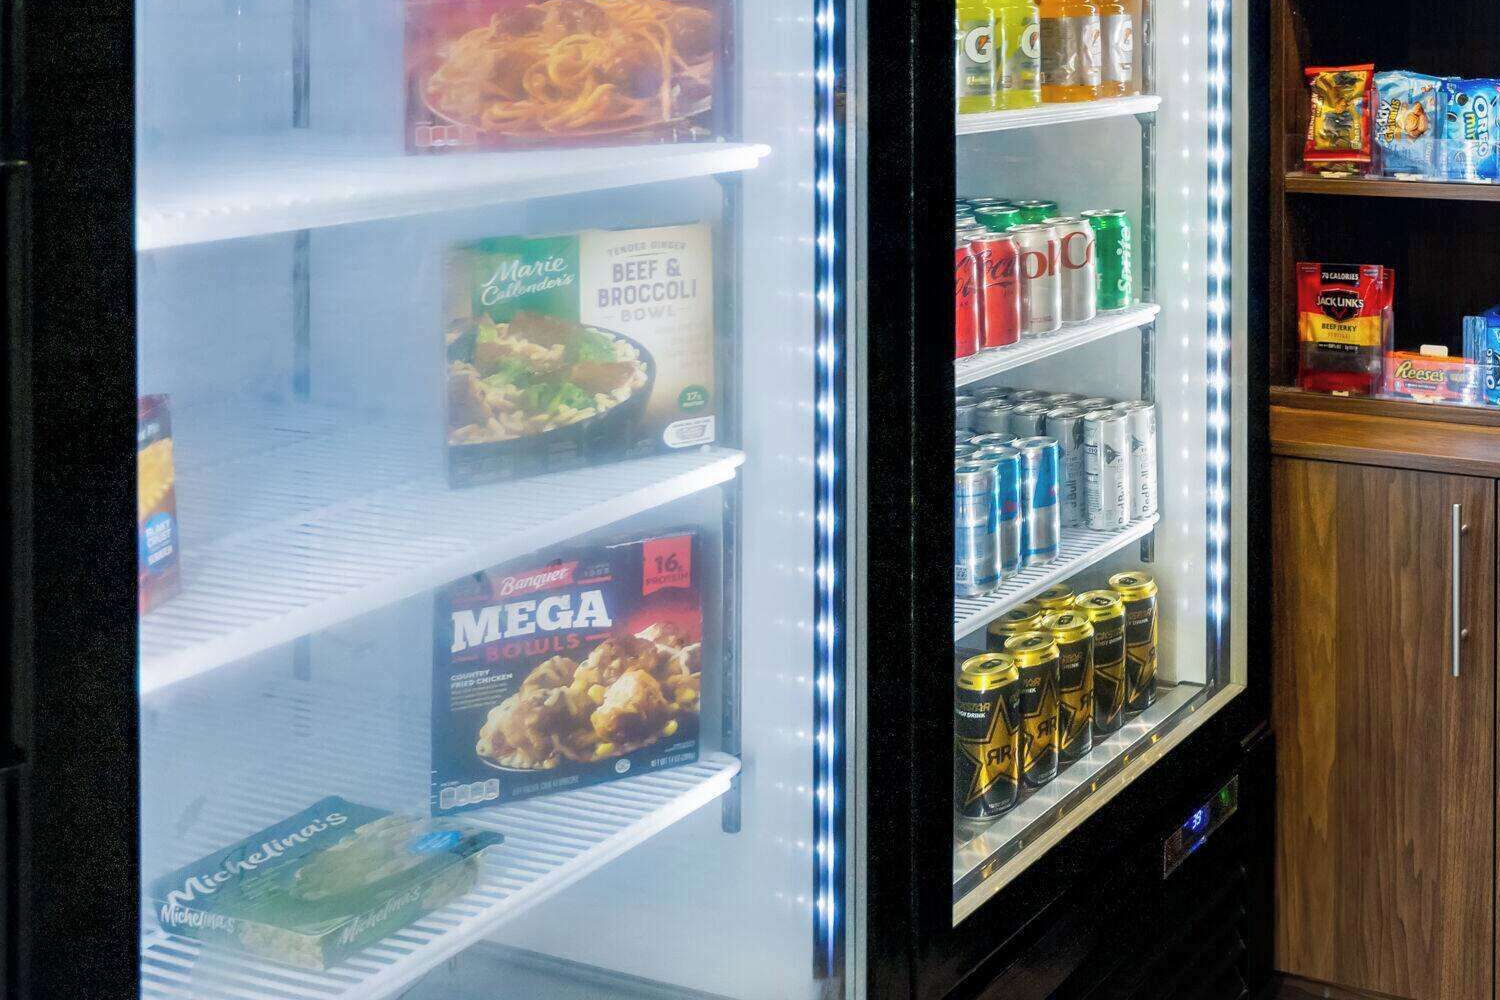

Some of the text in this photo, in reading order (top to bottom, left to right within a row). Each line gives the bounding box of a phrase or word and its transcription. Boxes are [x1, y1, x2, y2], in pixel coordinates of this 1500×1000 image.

[482, 256, 568, 288] Marie
[612, 257, 682, 284] BEEF &
[1329, 272, 1359, 281] CALORIES
[597, 278, 697, 309] BROCCOLI
[1316, 295, 1336, 307] JACK
[620, 305, 677, 323] BOWL
[1321, 322, 1358, 333] BEEF JERKY
[500, 566, 570, 597] Banquet
[645, 570, 690, 586] PROTEIN
[451, 589, 613, 653] MEGA
[485, 632, 581, 664] BOWLS
[476, 672, 513, 687] CHICKEN
[166, 812, 348, 907] Michelina's
